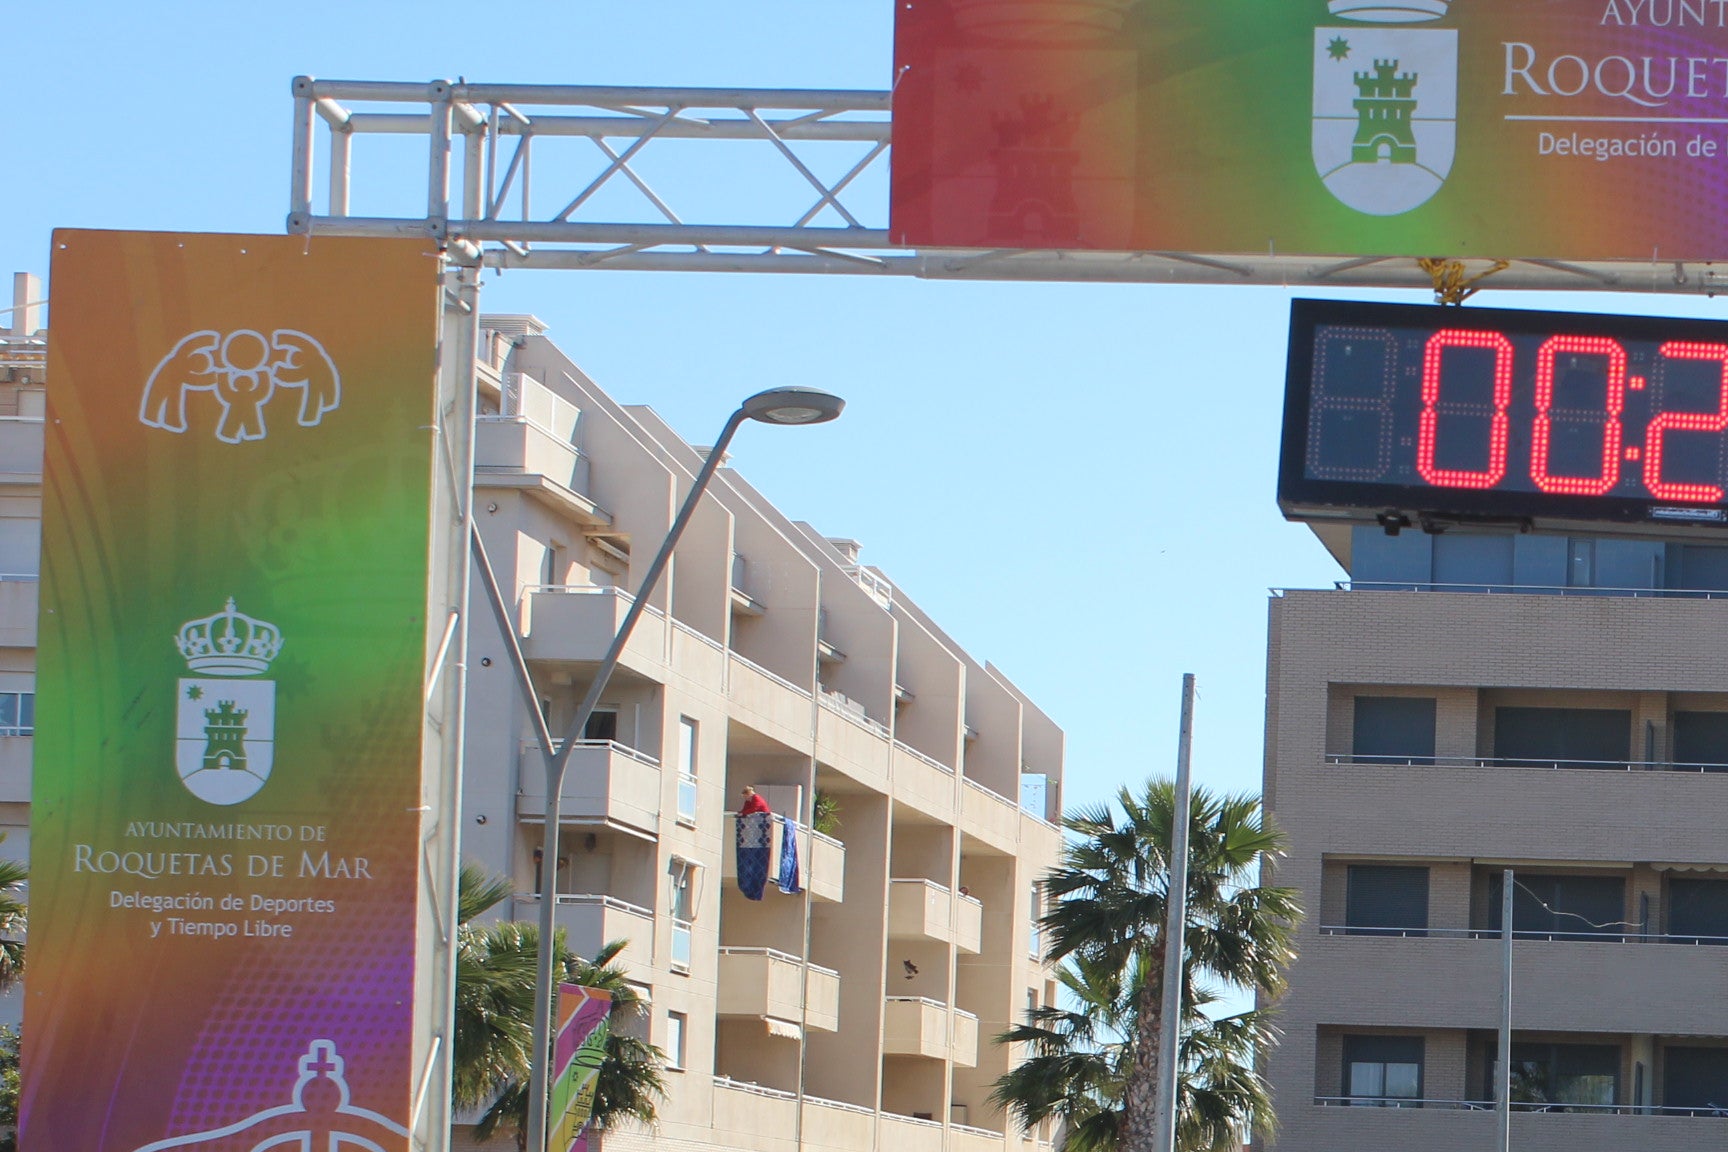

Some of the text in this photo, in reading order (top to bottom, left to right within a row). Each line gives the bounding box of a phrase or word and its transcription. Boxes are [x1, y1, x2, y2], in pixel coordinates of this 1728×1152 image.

[1538, 132, 1677, 161] Delegación
[1686, 134, 1718, 157] de
[124, 821, 327, 842] AYUNTAMIENTO DE
[73, 844, 373, 880] ROQUETAS DE MAR
[109, 891, 336, 915] Delegación de Deportes
[150, 917, 294, 939] y Tiempo Libre
